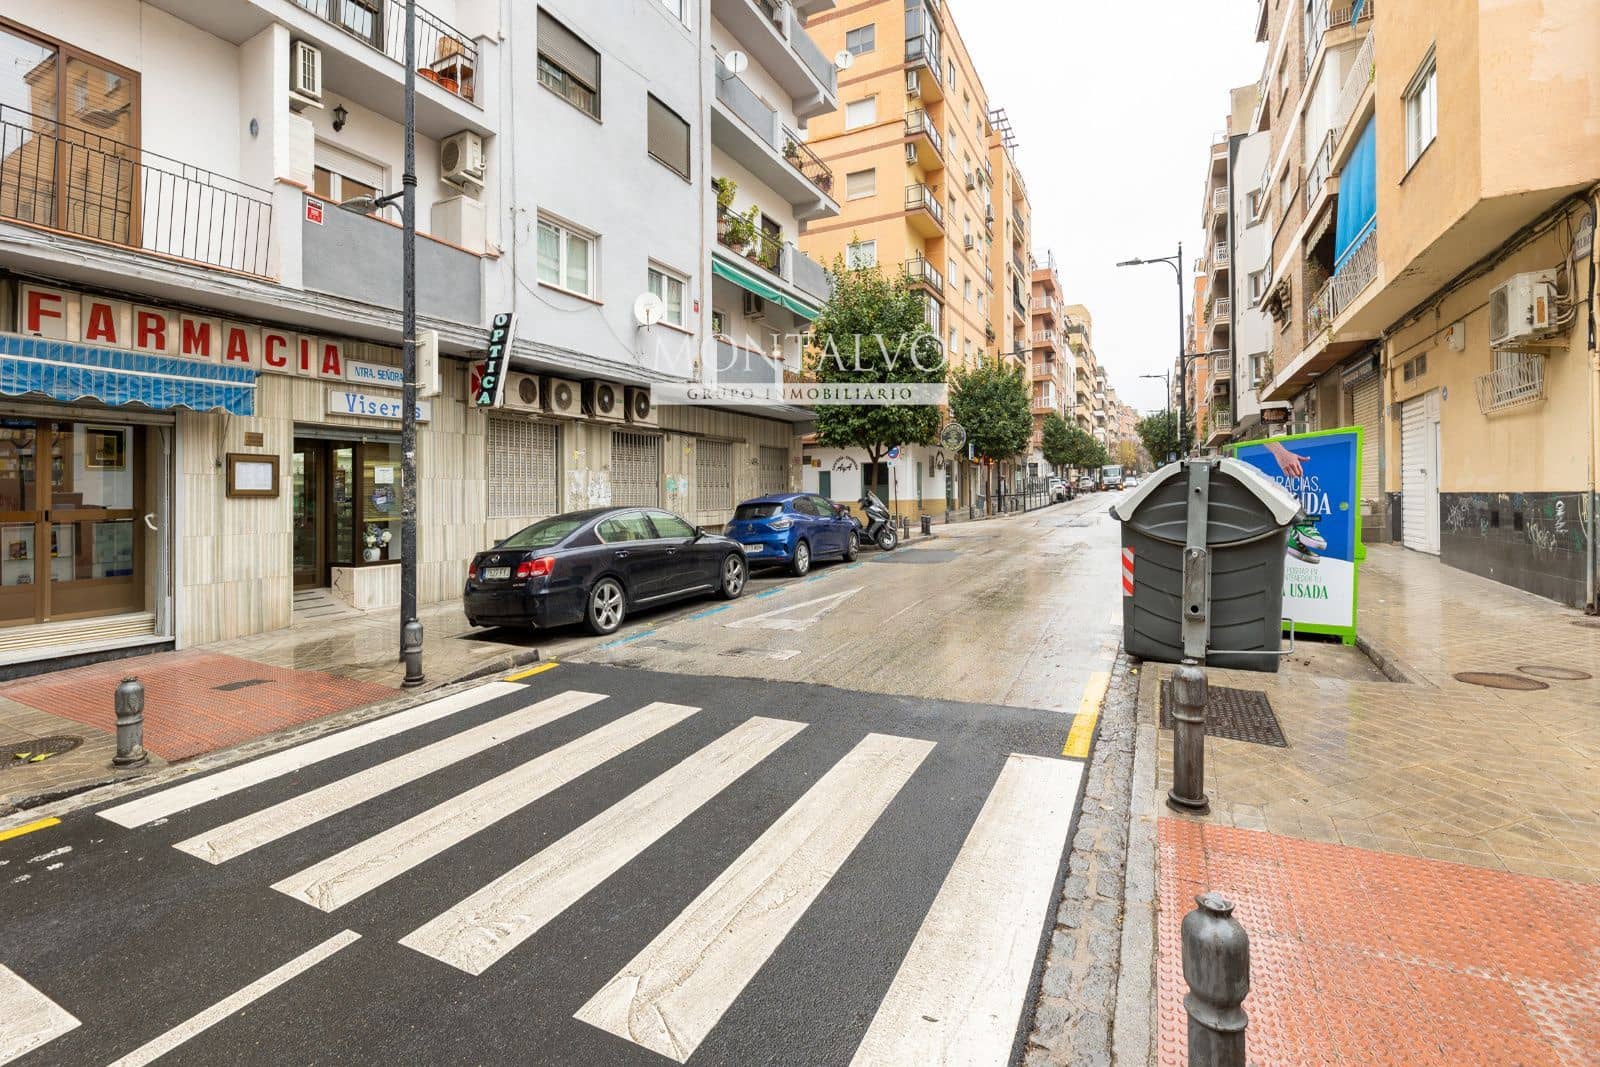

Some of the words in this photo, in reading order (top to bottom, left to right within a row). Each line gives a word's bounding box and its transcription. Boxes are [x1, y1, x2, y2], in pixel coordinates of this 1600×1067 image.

[28, 290, 341, 376] FARMACIA
[477, 313, 508, 405] OPTICA
[354, 366, 376, 378] NTRA.
[345, 391, 421, 418] Visers
[1272, 475, 1322, 494] RACIAS,
[1290, 583, 1329, 600] USADA
